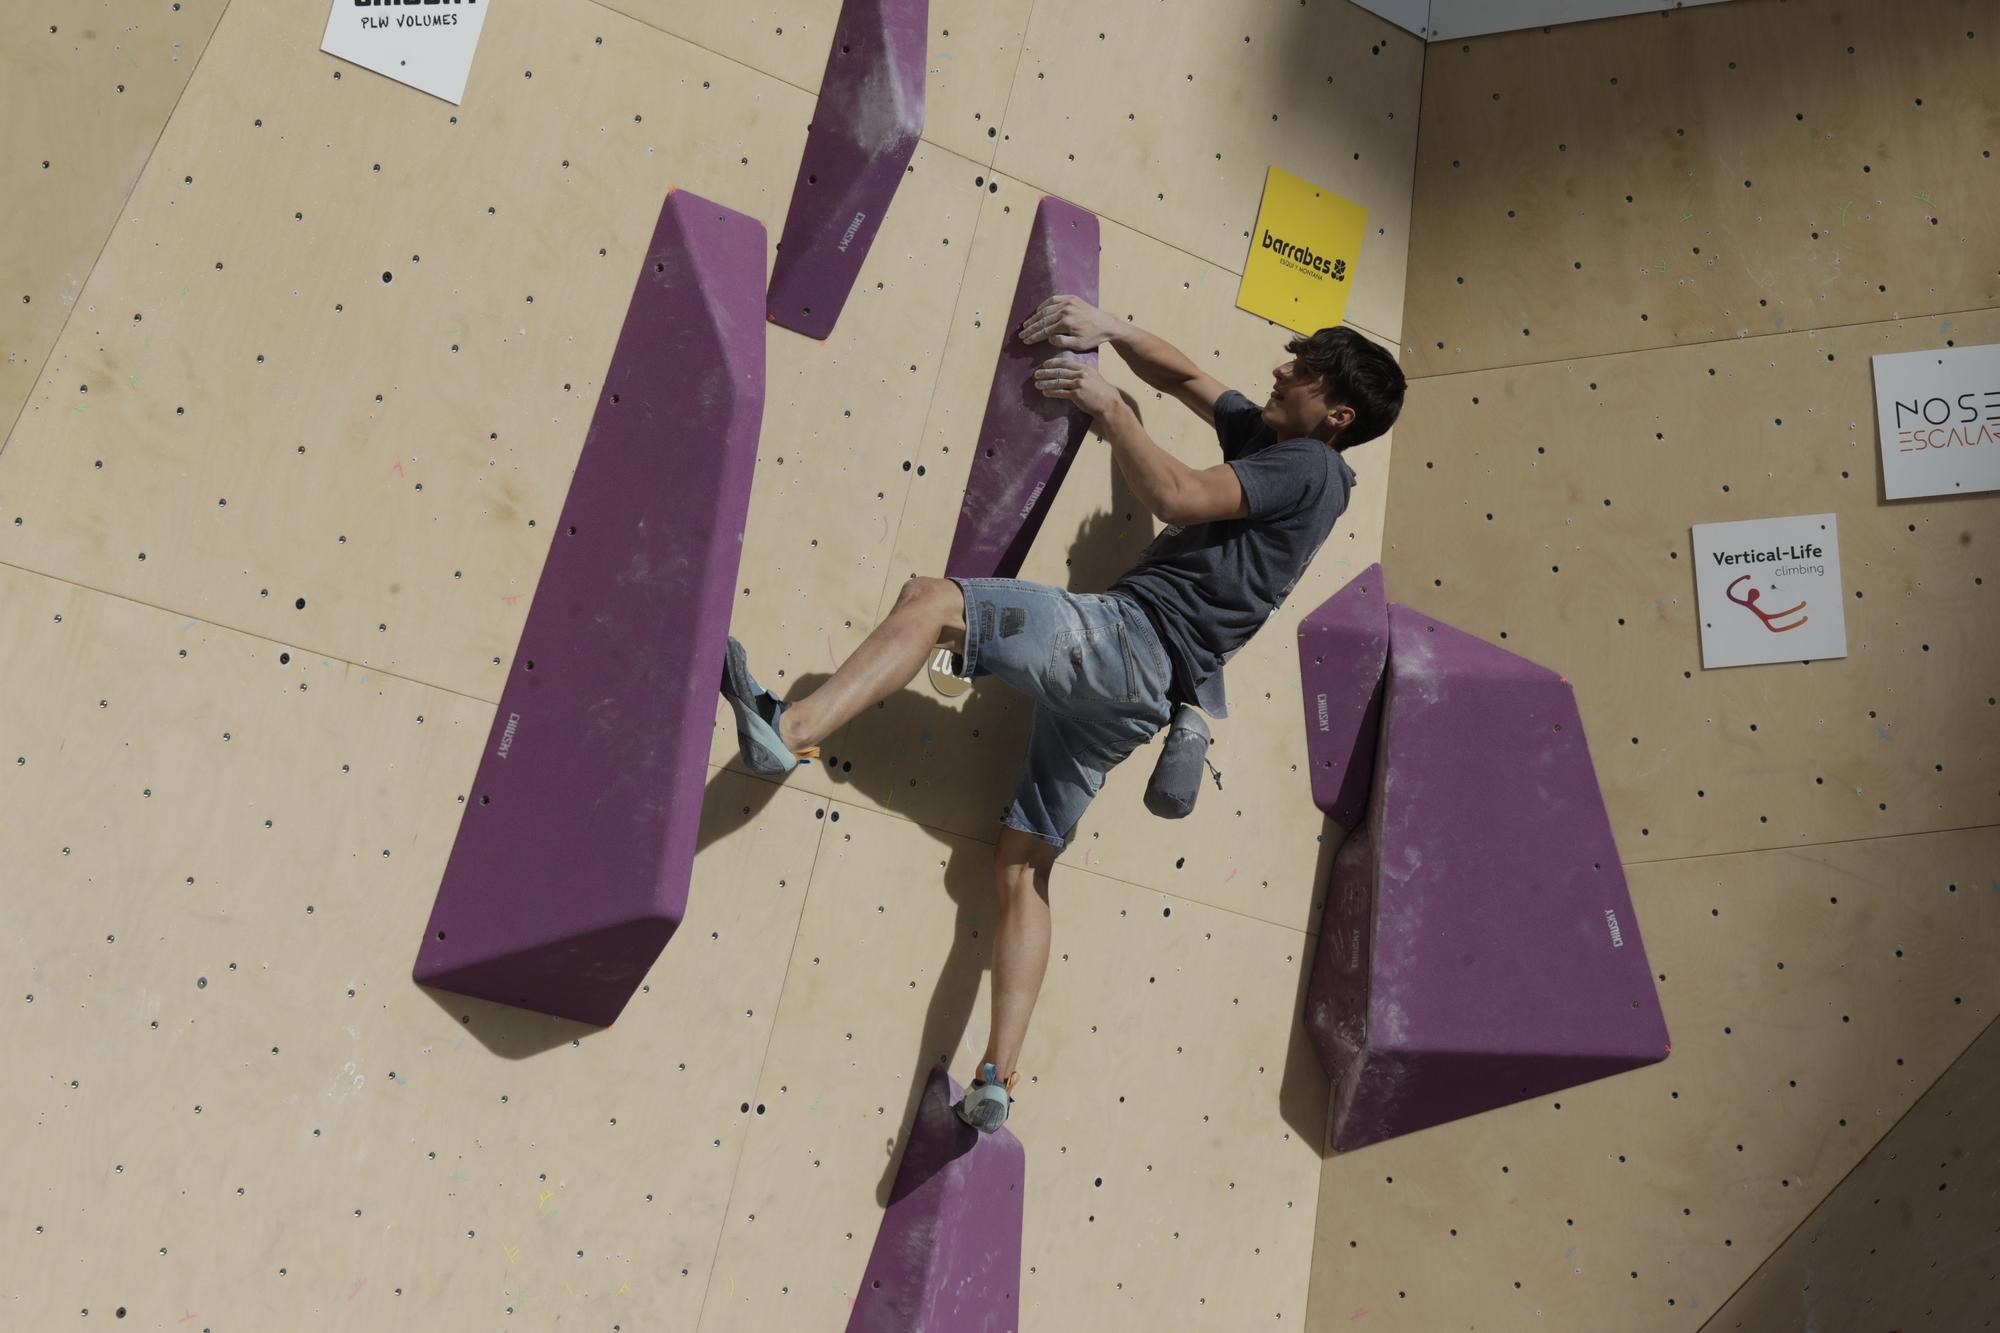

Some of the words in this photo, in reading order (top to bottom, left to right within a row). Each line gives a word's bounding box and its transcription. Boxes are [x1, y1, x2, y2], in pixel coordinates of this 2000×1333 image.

[361, 16, 389, 29] PLW
[397, 13, 458, 28] VOLUMES
[838, 212, 866, 252] CHIUSKY
[1262, 229, 1331, 274] barrabes
[1020, 481, 1046, 519] CHIUSKY
[1713, 544, 1822, 566] Vertical-Life
[1774, 564, 1824, 576] climbing
[1317, 693, 1330, 731] CHIUSKY
[497, 712, 520, 759] CHIUSKY
[1604, 909, 1623, 947] CHIUSKY
